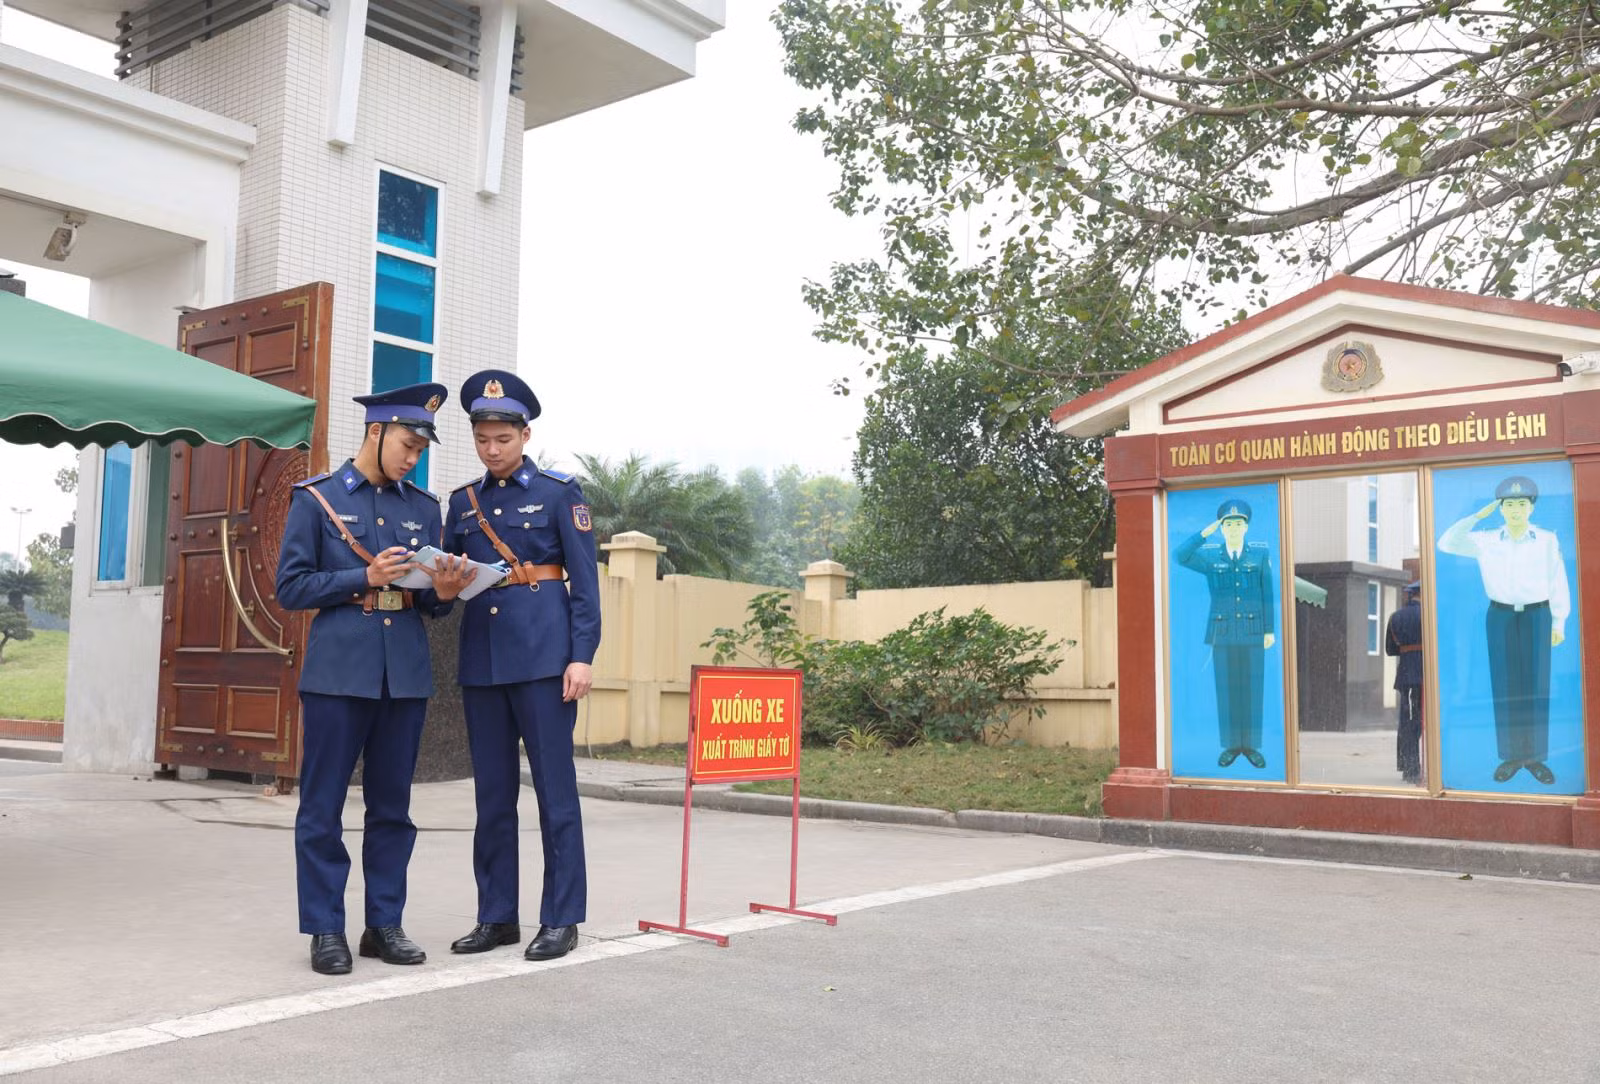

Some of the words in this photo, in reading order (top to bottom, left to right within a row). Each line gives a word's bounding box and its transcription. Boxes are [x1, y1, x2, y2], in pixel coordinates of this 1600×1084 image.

[1170, 442, 1210, 467] TOÀN
[1215, 440, 1236, 463] CƠ
[1241, 437, 1285, 463] QUAN
[1291, 430, 1336, 457] HÀNH
[1341, 426, 1390, 457] ĐỘNG
[1394, 423, 1440, 449] THEO
[1447, 411, 1489, 444] ĐIỀU
[1495, 411, 1546, 444] LỆNH
[710, 689, 762, 724] XUỐNG
[766, 698, 784, 723] XE
[702, 733, 727, 760] XUẤT
[729, 735, 755, 759] TRÌNH
[757, 731, 777, 757] GIẤY
[779, 732, 790, 756] TỜ
